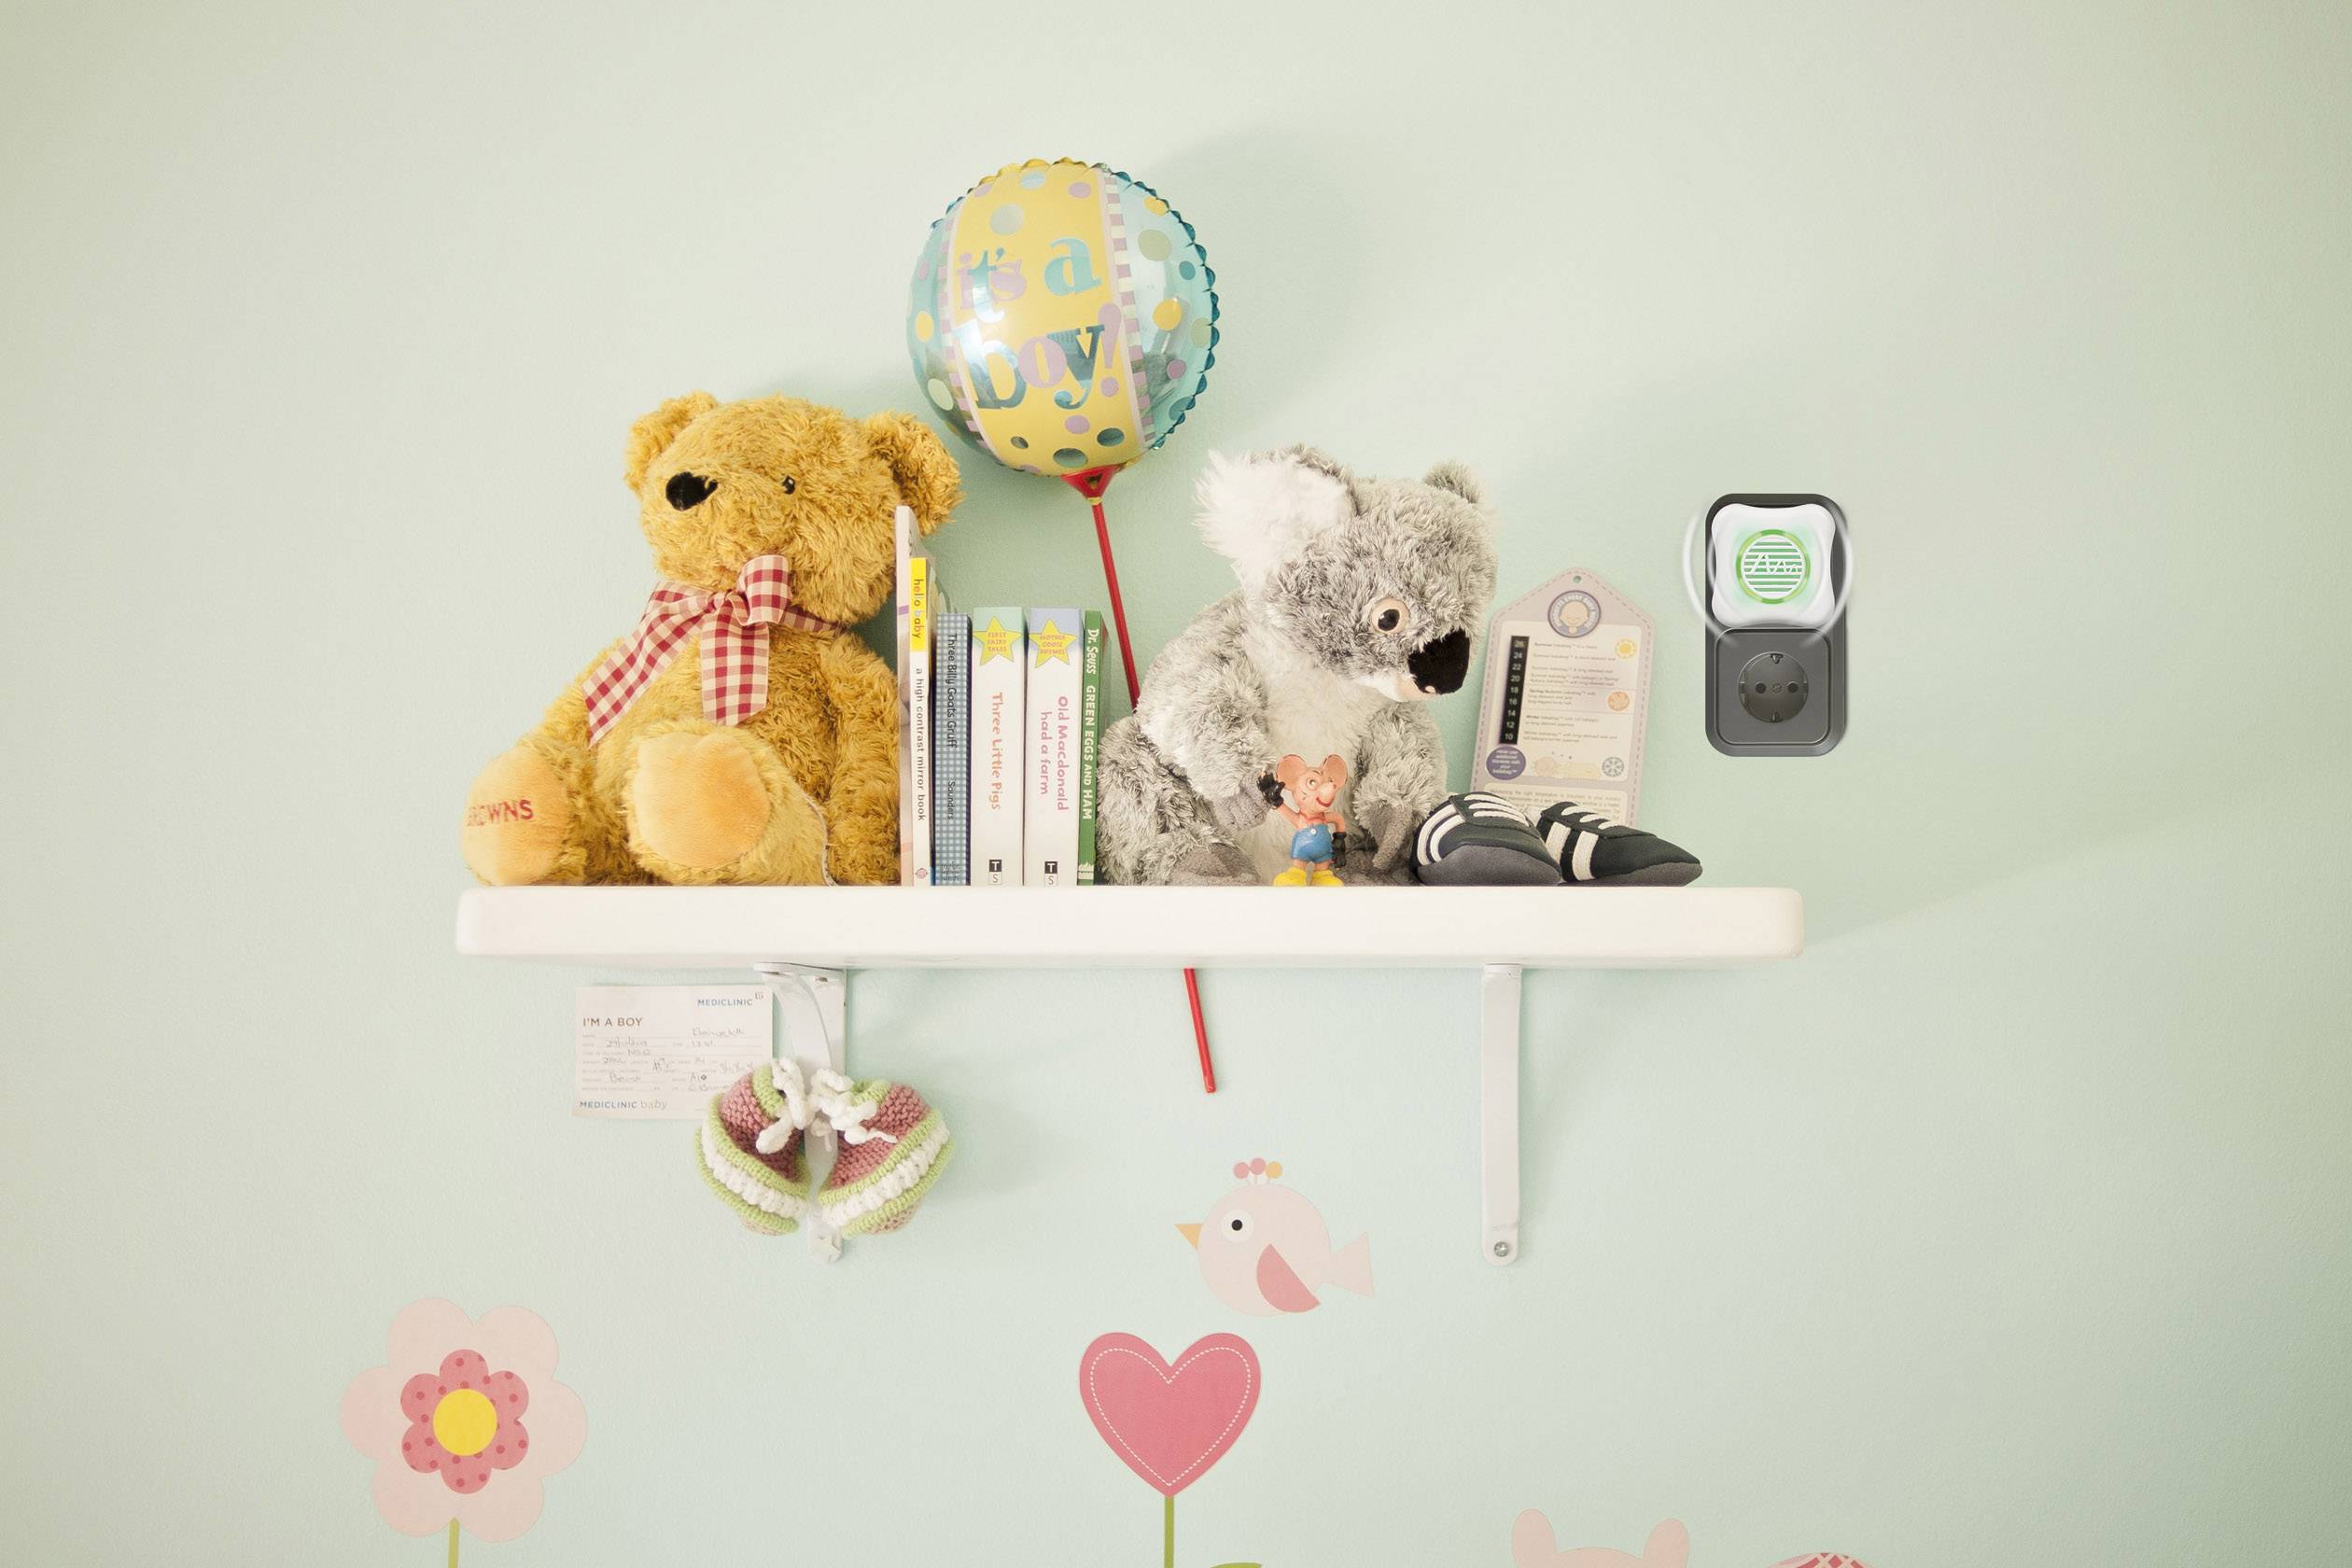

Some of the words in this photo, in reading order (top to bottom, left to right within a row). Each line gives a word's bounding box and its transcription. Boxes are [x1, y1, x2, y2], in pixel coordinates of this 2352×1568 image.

[957, 246, 1028, 323] it's
[1044, 238, 1102, 296] a
[952, 302, 1121, 410] boy!
[913, 579, 925, 607] hello
[912, 610, 925, 638] baby
[1086, 628, 1099, 644] Dr.
[946, 633, 958, 661] Three
[1085, 646, 1099, 674] Seuss
[945, 665, 958, 684] Billy
[915, 679, 925, 702] high
[946, 687, 958, 718] Goats
[992, 692, 1004, 735] Three
[1057, 696, 1070, 721] Old
[1085, 685, 1097, 726] GREEN
[917, 706, 925, 752] contrast
[946, 721, 958, 748] Gruff
[1041, 711, 1052, 740] had
[991, 739, 1003, 778] Little
[1041, 744, 1048, 754] a
[1084, 731, 1095, 762] EGGS
[917, 756, 925, 790] mirror
[1040, 759, 1051, 794] farm
[1057, 725, 1070, 811] Macdonald
[1083, 764, 1093, 786] AND
[917, 795, 927, 821] book
[946, 780, 956, 820] Saunders
[989, 782, 1003, 810] Pigs
[1082, 789, 1094, 819] HAM
[582, 1017, 600, 1027] I'M
[604, 1017, 613, 1027] A
[617, 1016, 643, 1027] BOY
[579, 1100, 637, 1109] MEDICLINIC
[640, 1099, 668, 1110] baby
